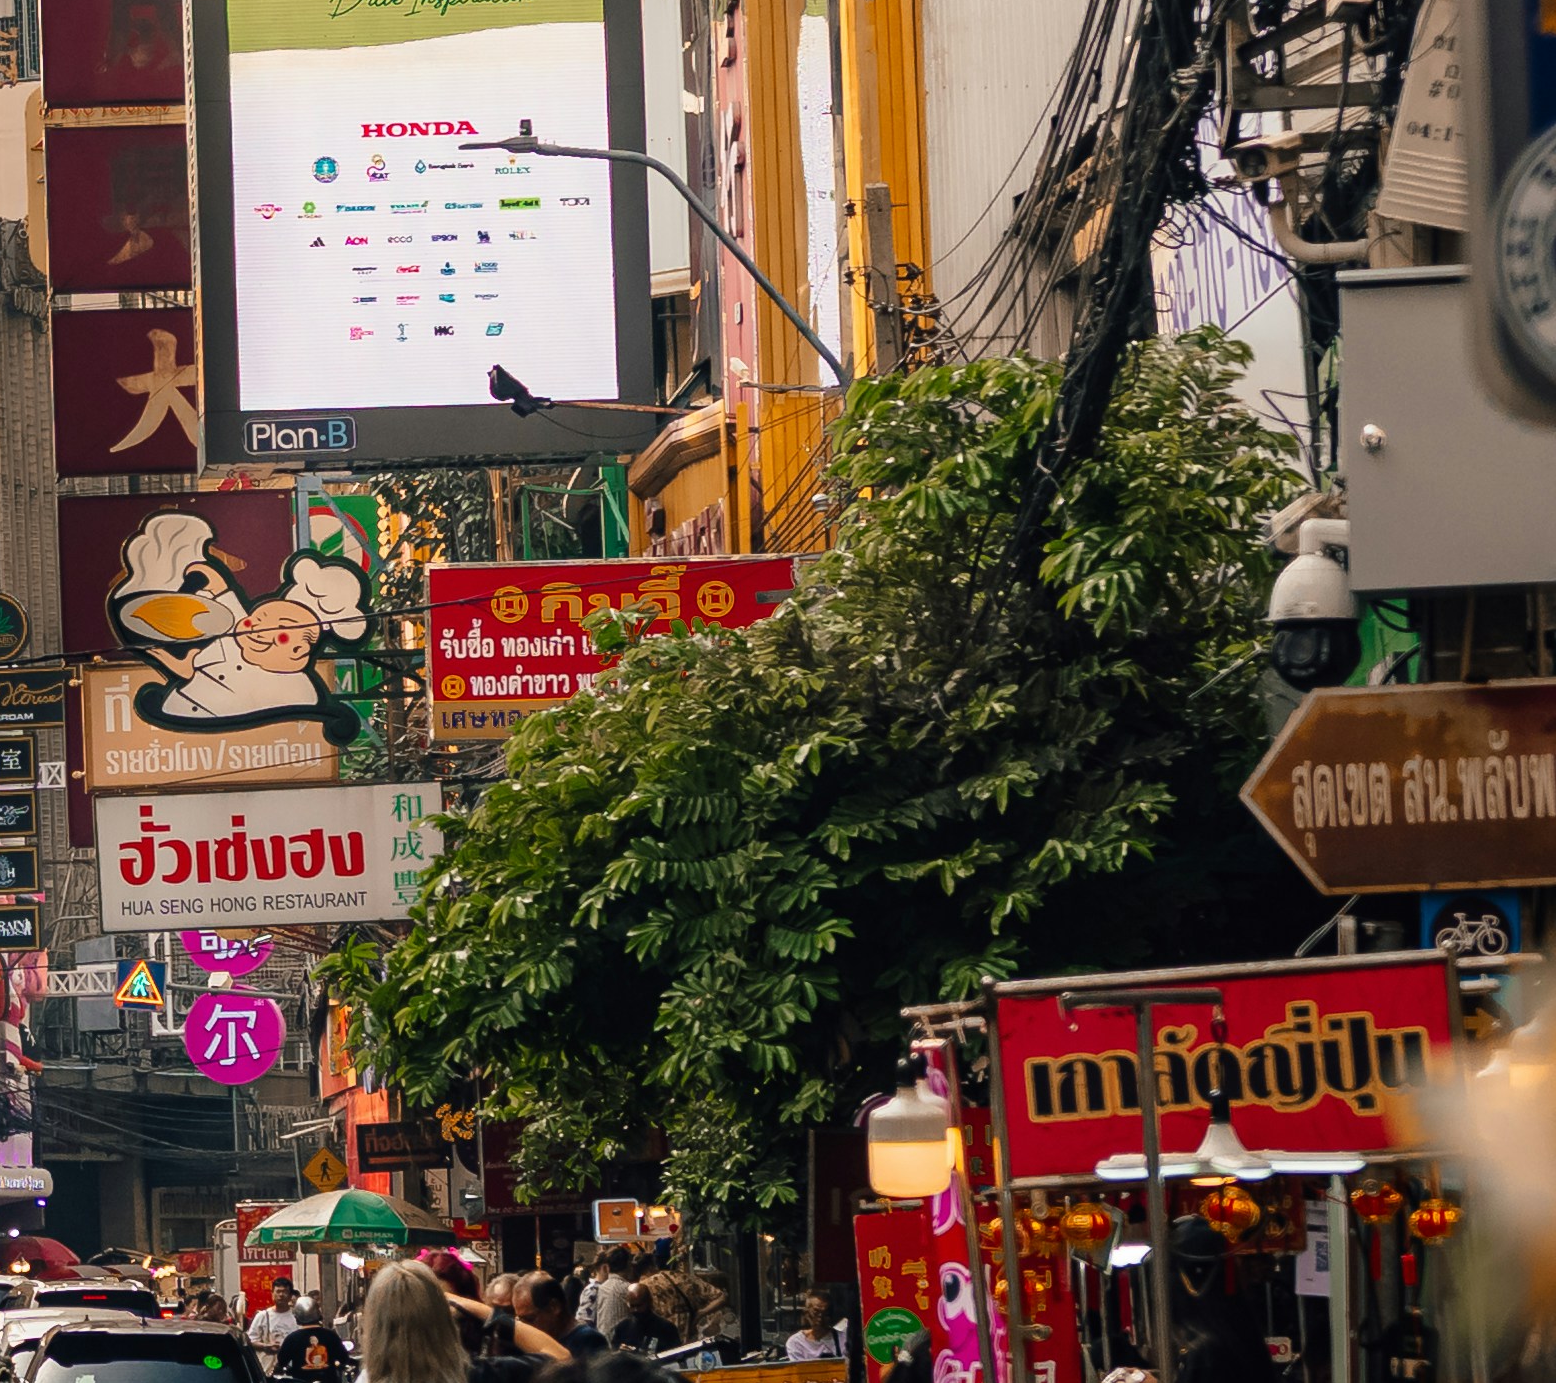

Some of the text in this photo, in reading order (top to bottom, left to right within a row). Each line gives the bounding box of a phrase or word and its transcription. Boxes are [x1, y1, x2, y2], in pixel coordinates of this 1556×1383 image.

[360, 120, 479, 138] HONDA
[494, 166, 532, 175] ROLEX
[344, 235, 369, 246] AON
[430, 233, 459, 242] EPSON
[439, 618, 495, 659] รับซื้อ
[469, 665, 571, 697] ทองคำขาว
[441, 708, 528, 730] เศษทอ
[104, 739, 323, 775] รายชั่วโมง/รายเดือน
[1291, 758, 1393, 859] สุดเขต
[118, 804, 366, 886] ฮั่วเซ่งฮง
[120, 890, 369, 916] HUA SENG HONG RESTAURANT
